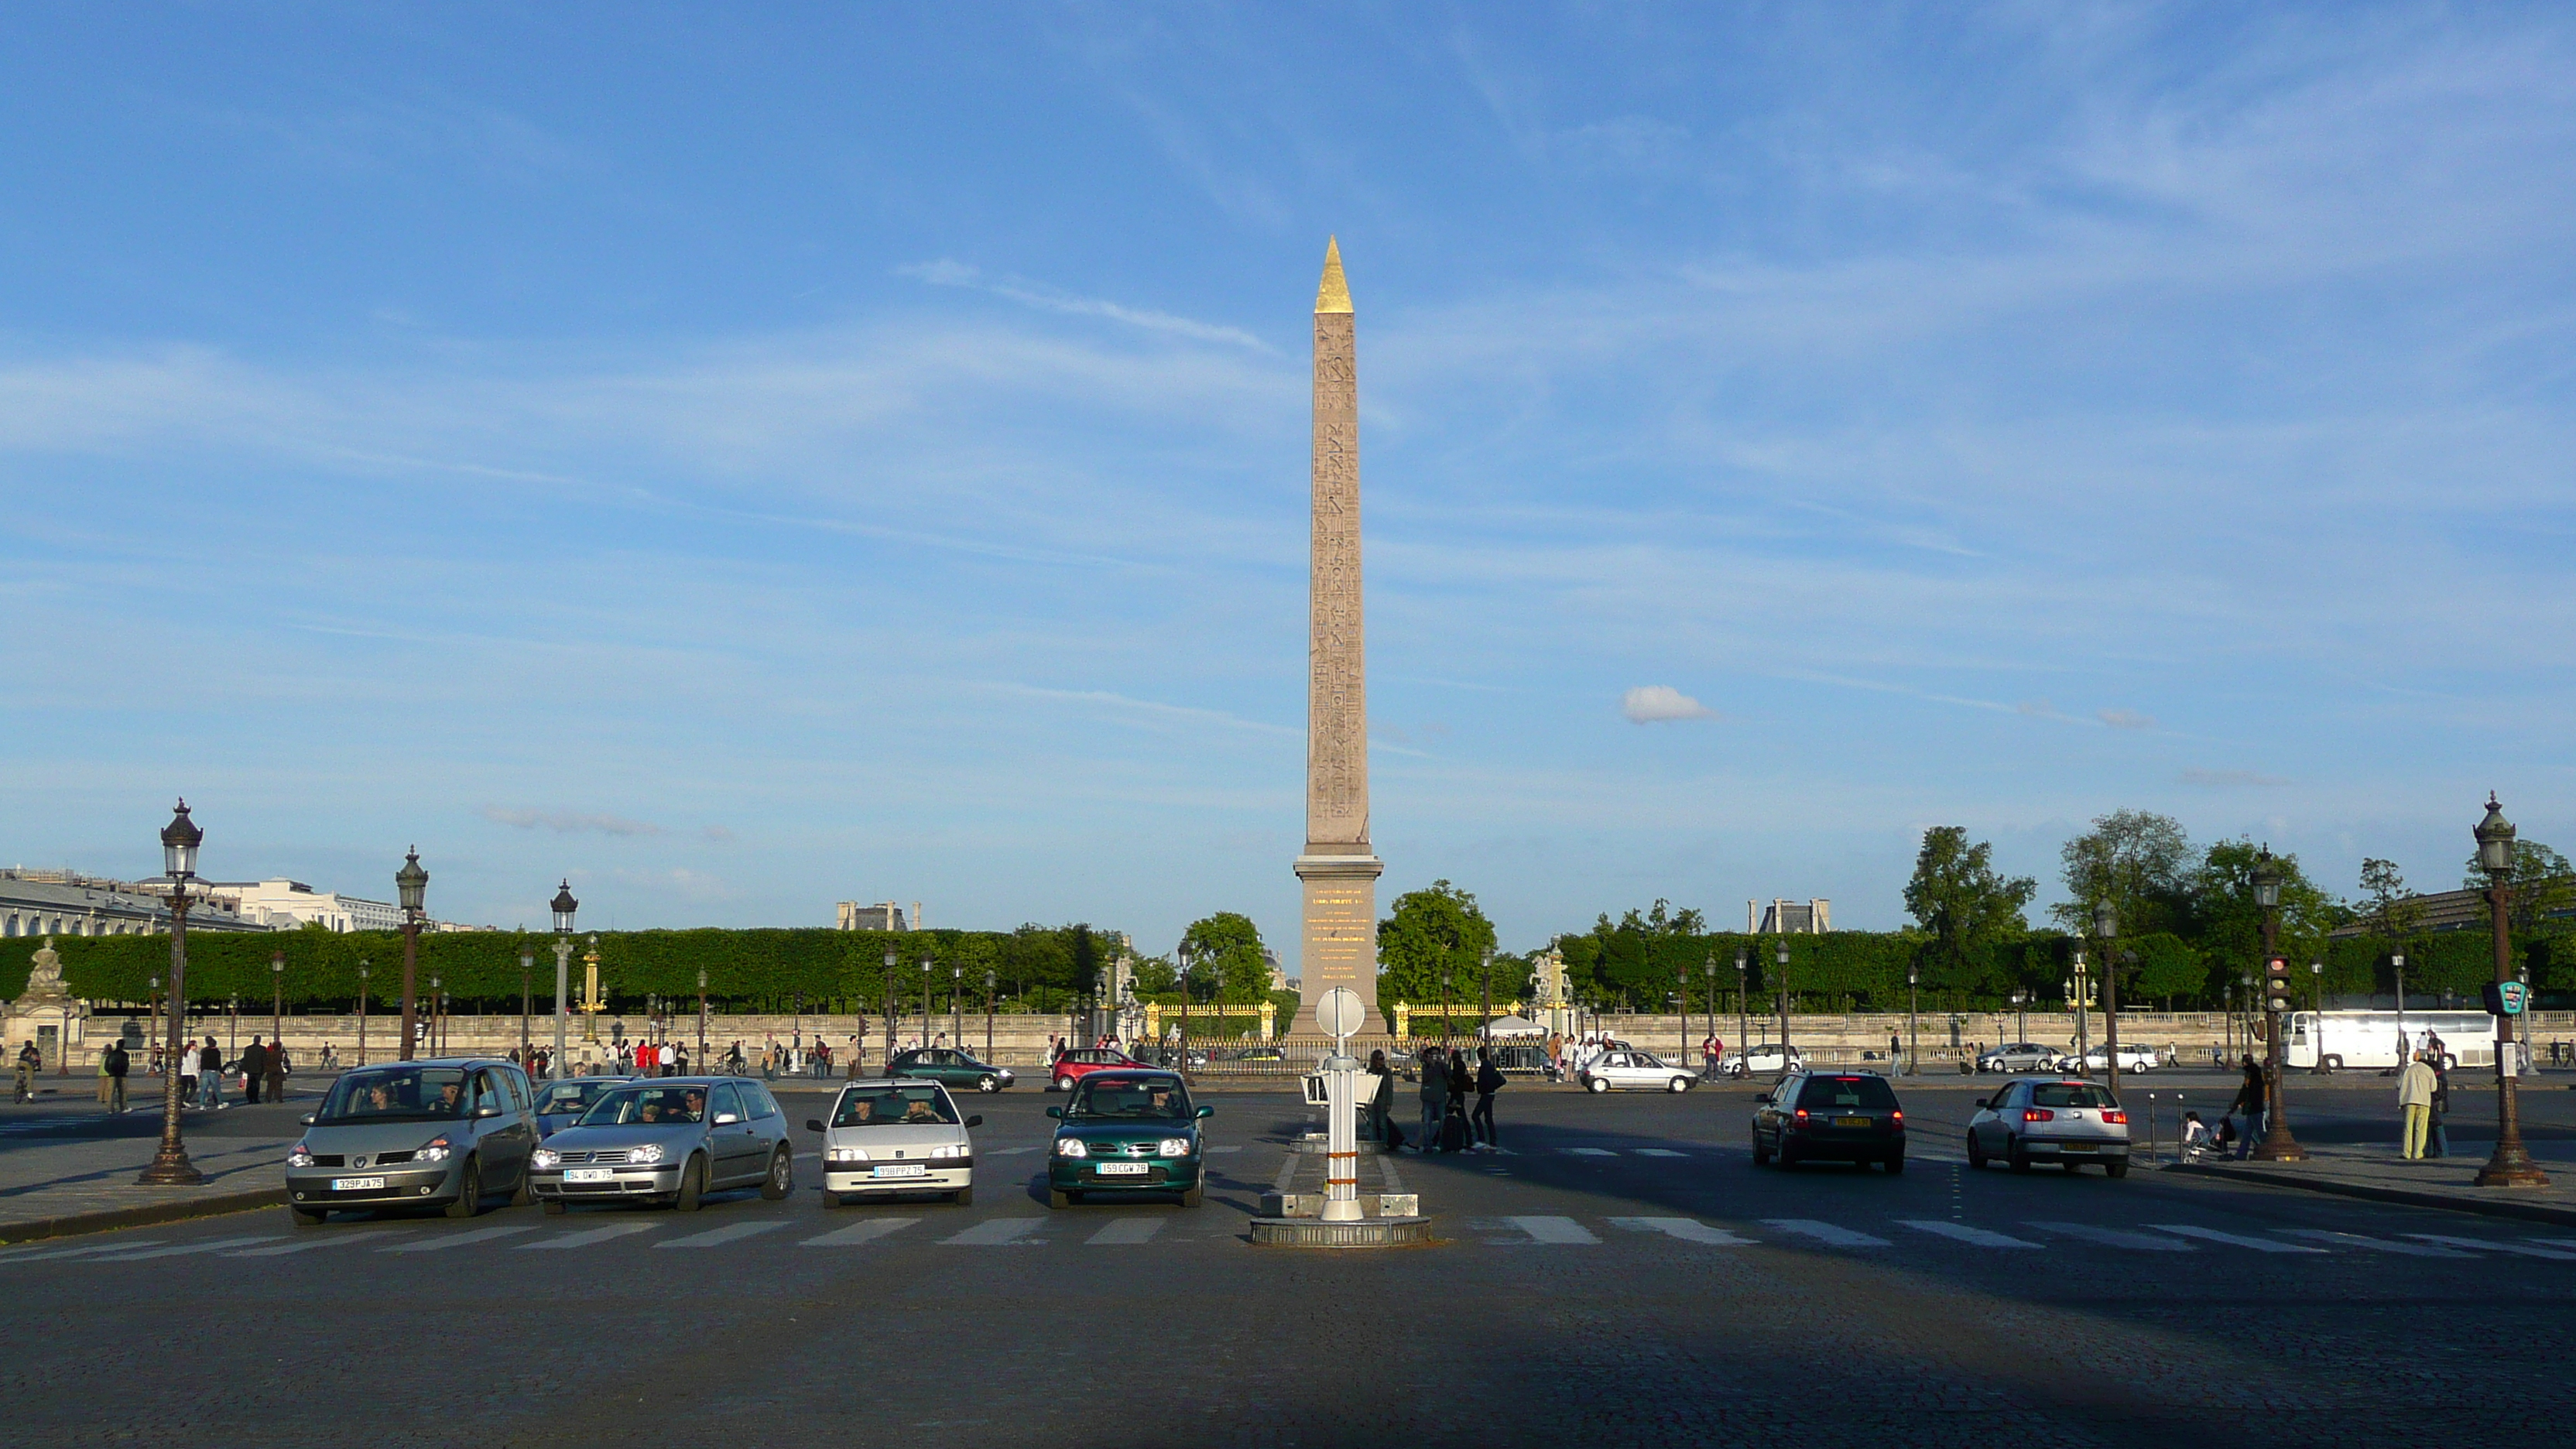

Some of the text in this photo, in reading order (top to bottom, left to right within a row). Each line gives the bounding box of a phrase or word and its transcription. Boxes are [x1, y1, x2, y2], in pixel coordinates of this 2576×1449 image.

[1103, 1164, 1117, 1173] 159
[1136, 1164, 1146, 1173] 78
[570, 1171, 579, 1180] 94
[601, 1170, 611, 1179] 75
